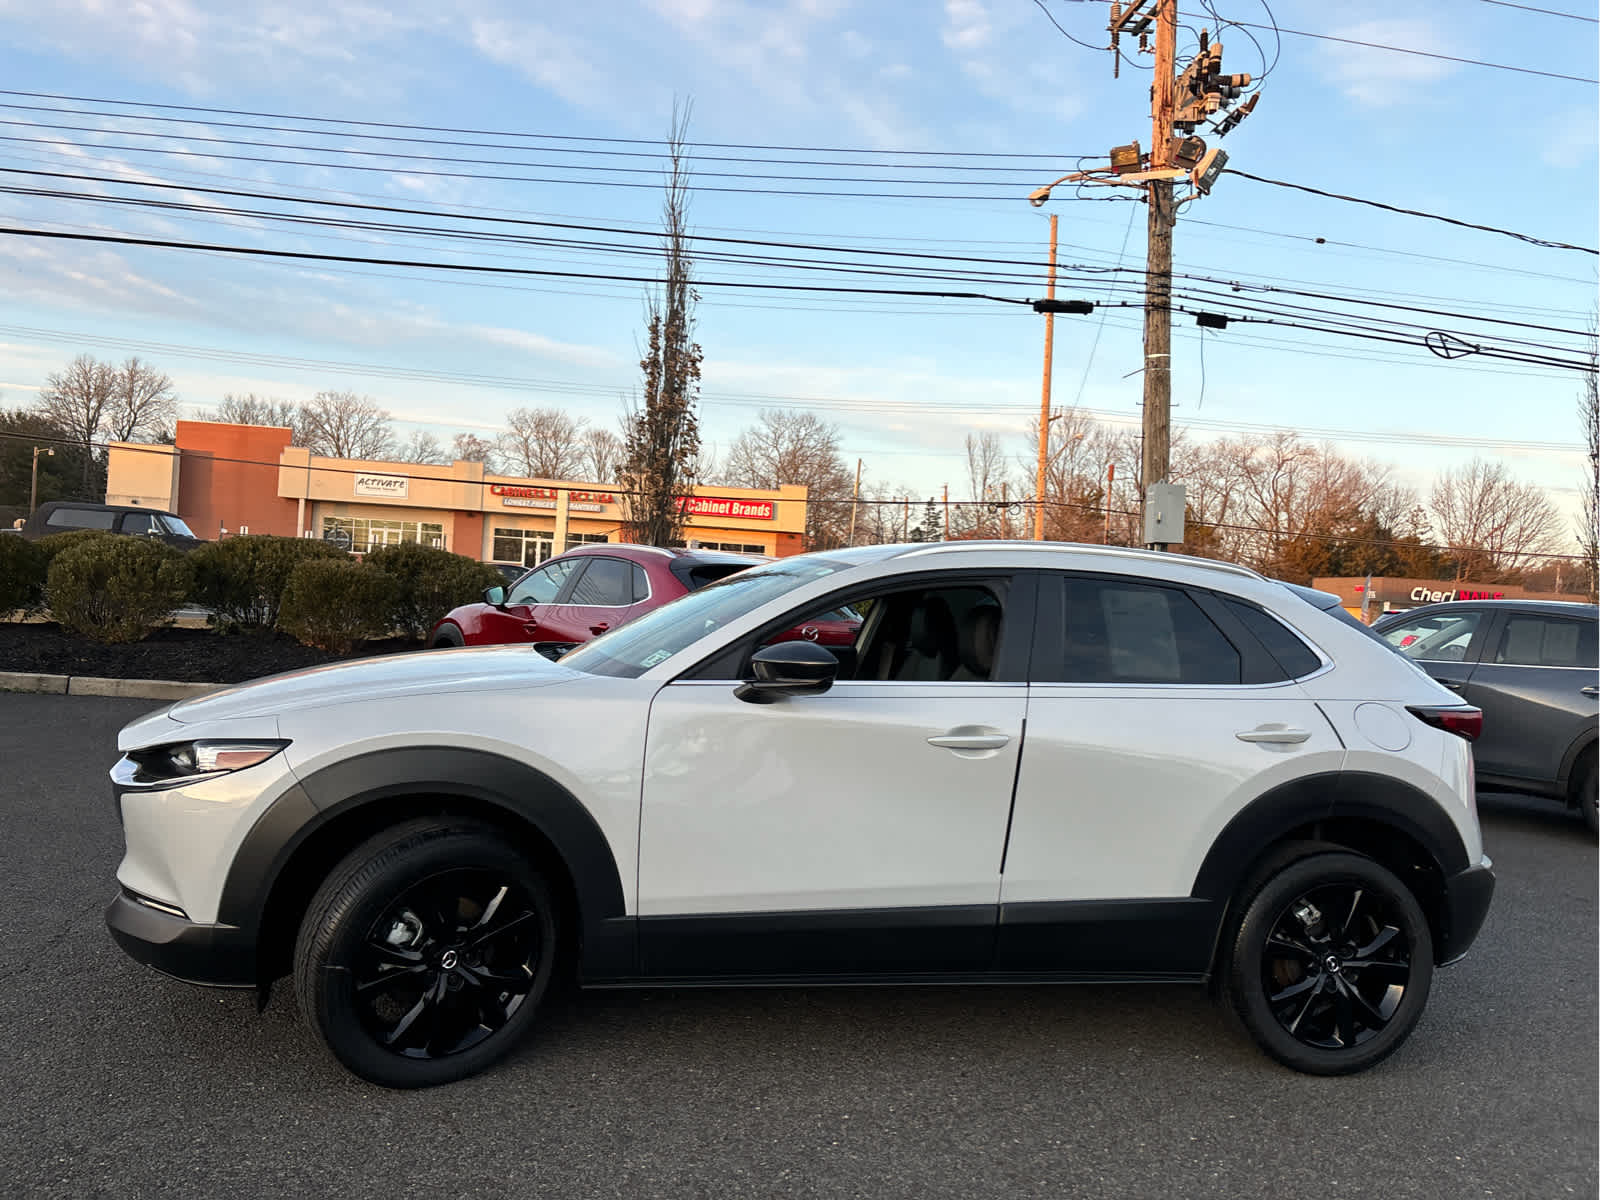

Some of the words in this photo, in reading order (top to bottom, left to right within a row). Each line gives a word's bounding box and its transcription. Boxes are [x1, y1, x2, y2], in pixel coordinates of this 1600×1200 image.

[358, 478, 405, 488] ACTIVATE
[592, 492, 615, 504] USA
[687, 499, 730, 514] Cabinet
[732, 503, 770, 517] Brands
[1410, 587, 1456, 602] Cheri
